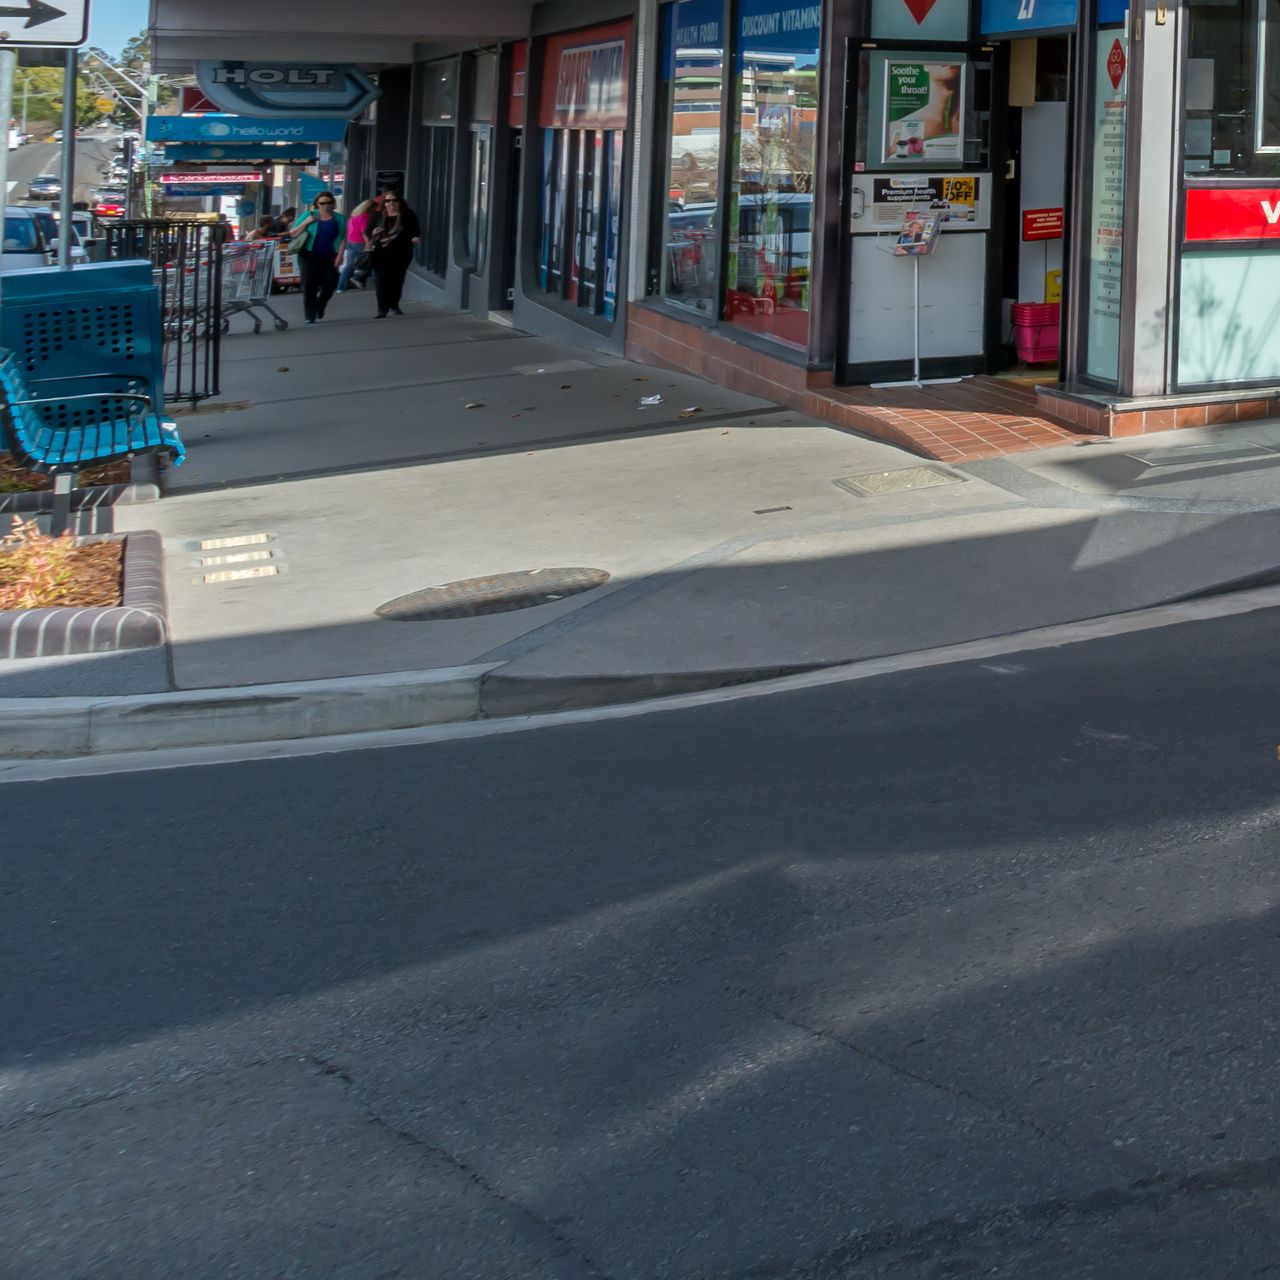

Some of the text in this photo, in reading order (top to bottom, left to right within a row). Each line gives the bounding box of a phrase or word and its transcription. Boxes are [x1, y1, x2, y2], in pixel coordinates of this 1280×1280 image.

[741, 10, 780, 37] DISCOUNT
[699, 21, 719, 43] FOODS
[214, 68, 336, 84] HOLT
[891, 66, 920, 75] Soothe
[898, 76, 916, 85] your
[901, 85, 928, 94] throat!
[945, 180, 973, 191] 30%
[881, 188, 914, 196] Premium
[944, 190, 973, 202] OFF
